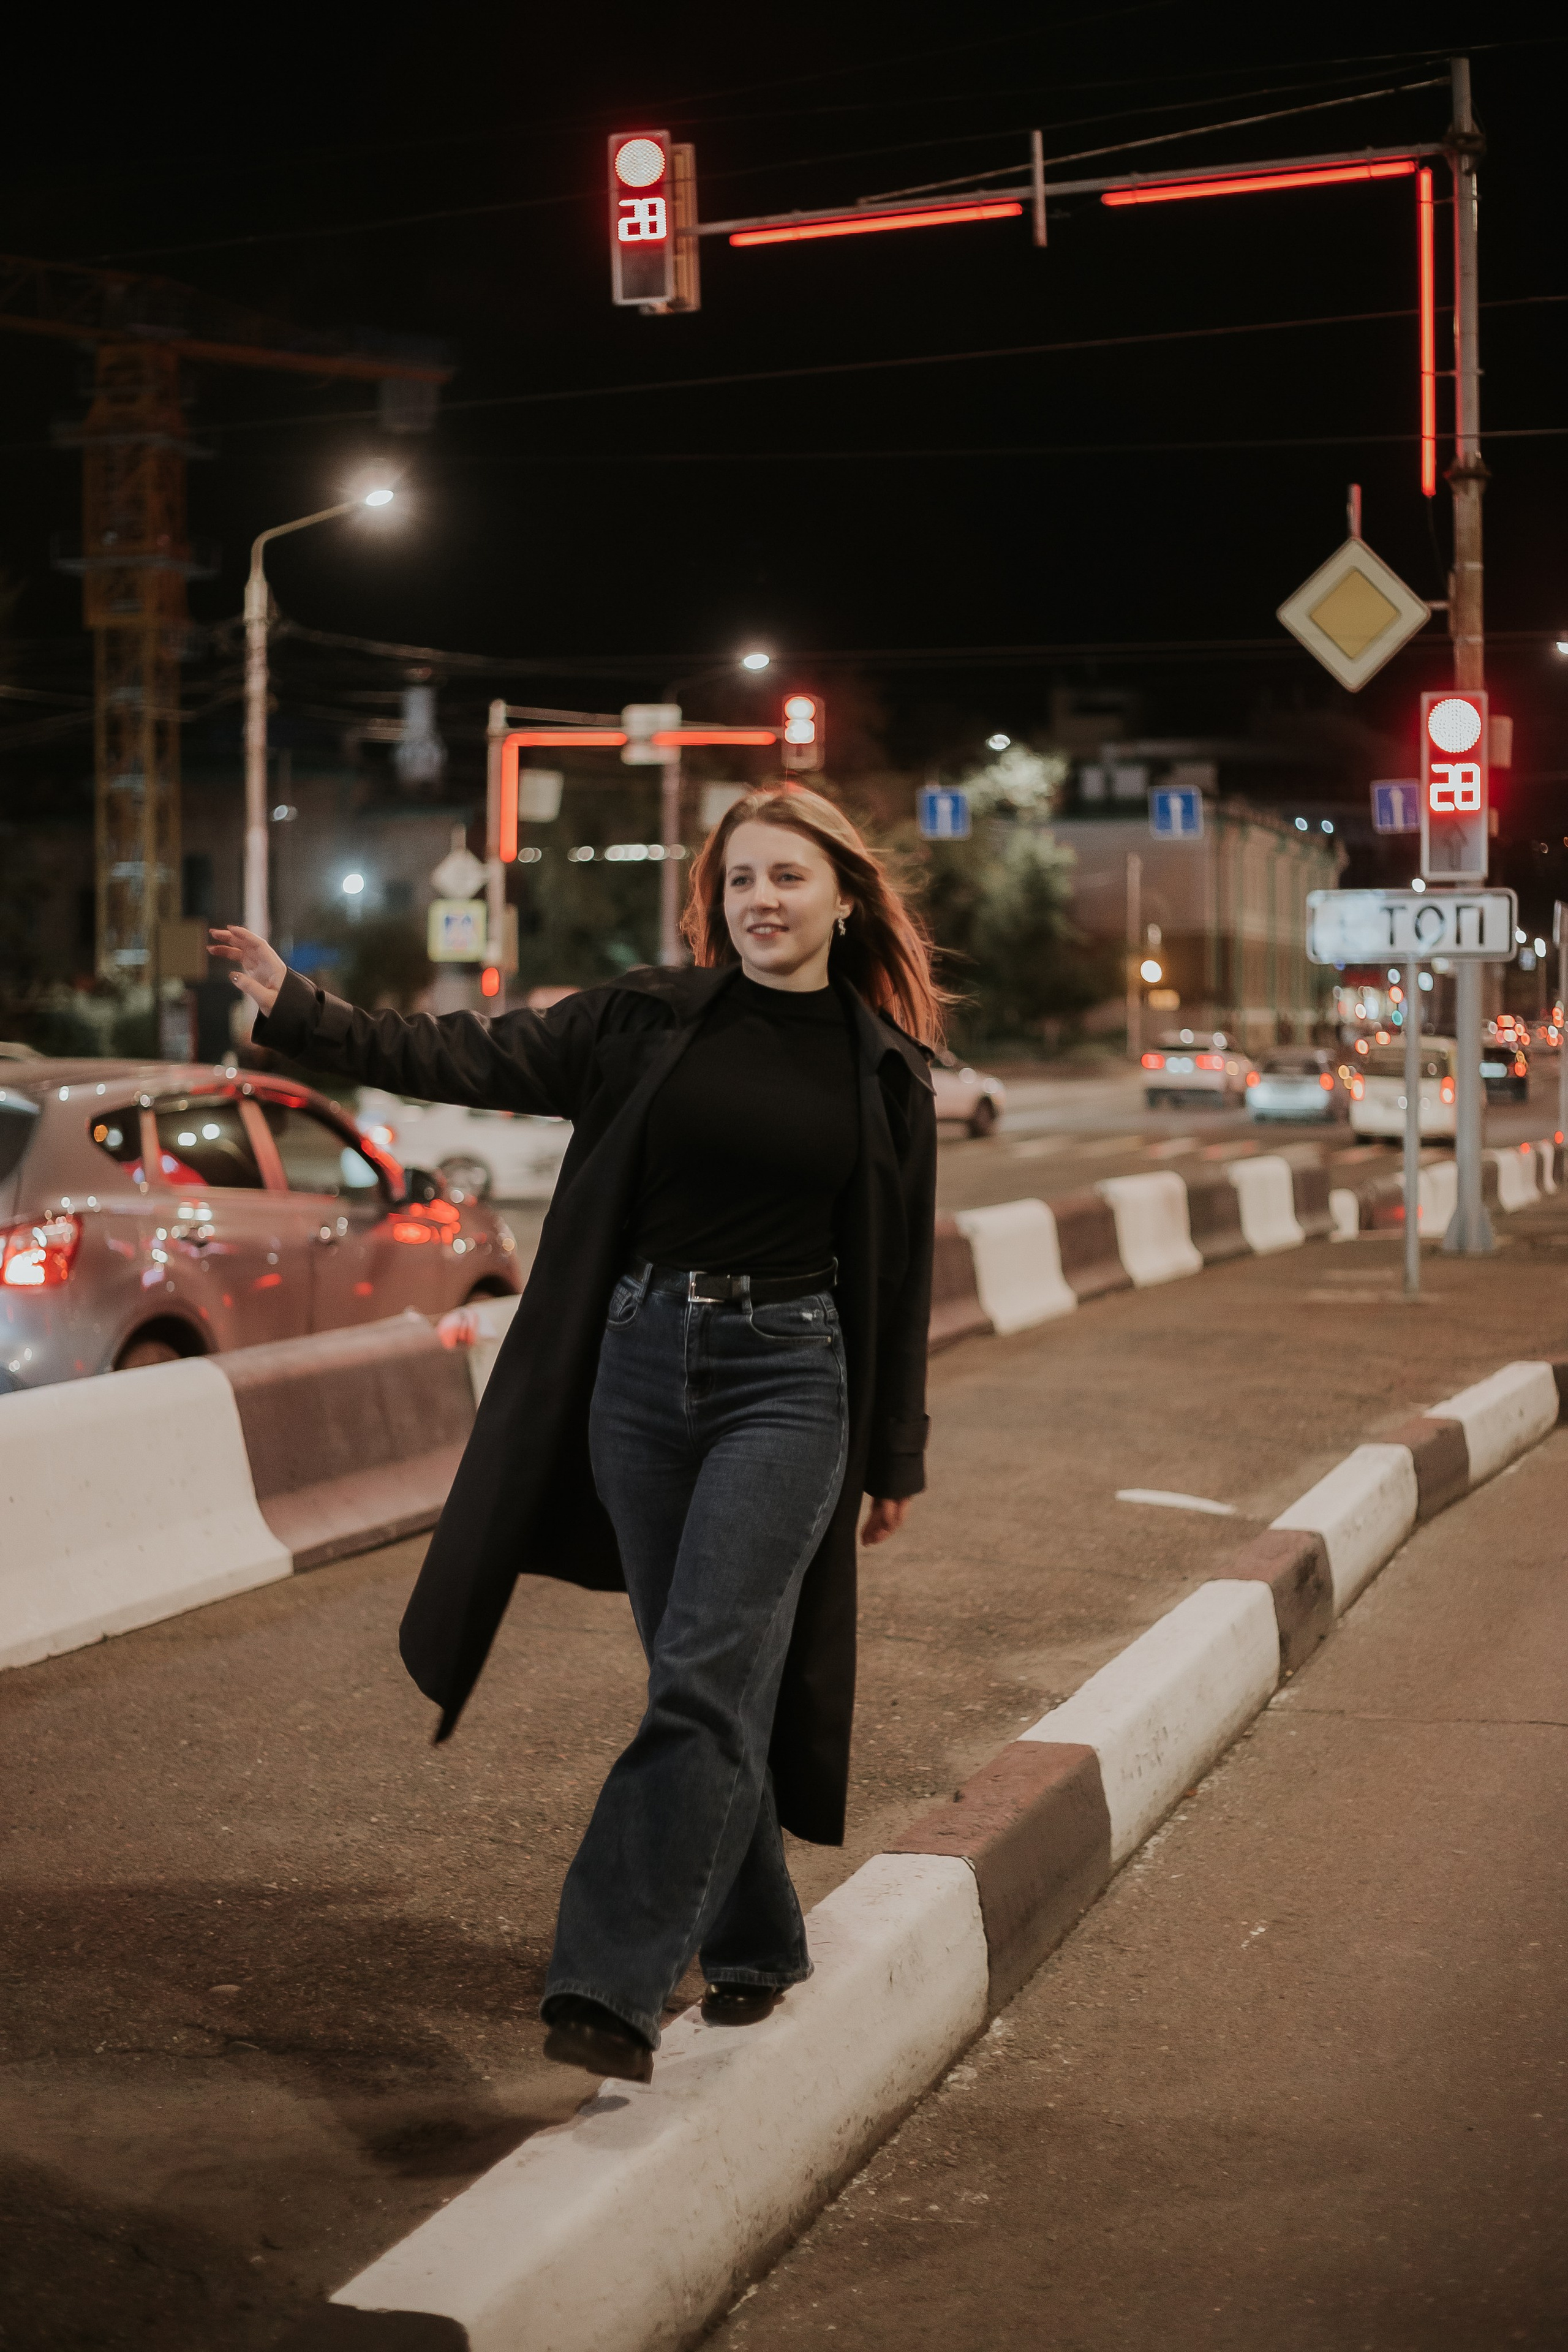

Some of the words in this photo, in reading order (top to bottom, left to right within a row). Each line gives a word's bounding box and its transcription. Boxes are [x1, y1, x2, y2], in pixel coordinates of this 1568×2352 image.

[617, 197, 667, 241] 28
[1429, 763, 1481, 812] 28
[1340, 905, 1484, 946] ТОП
